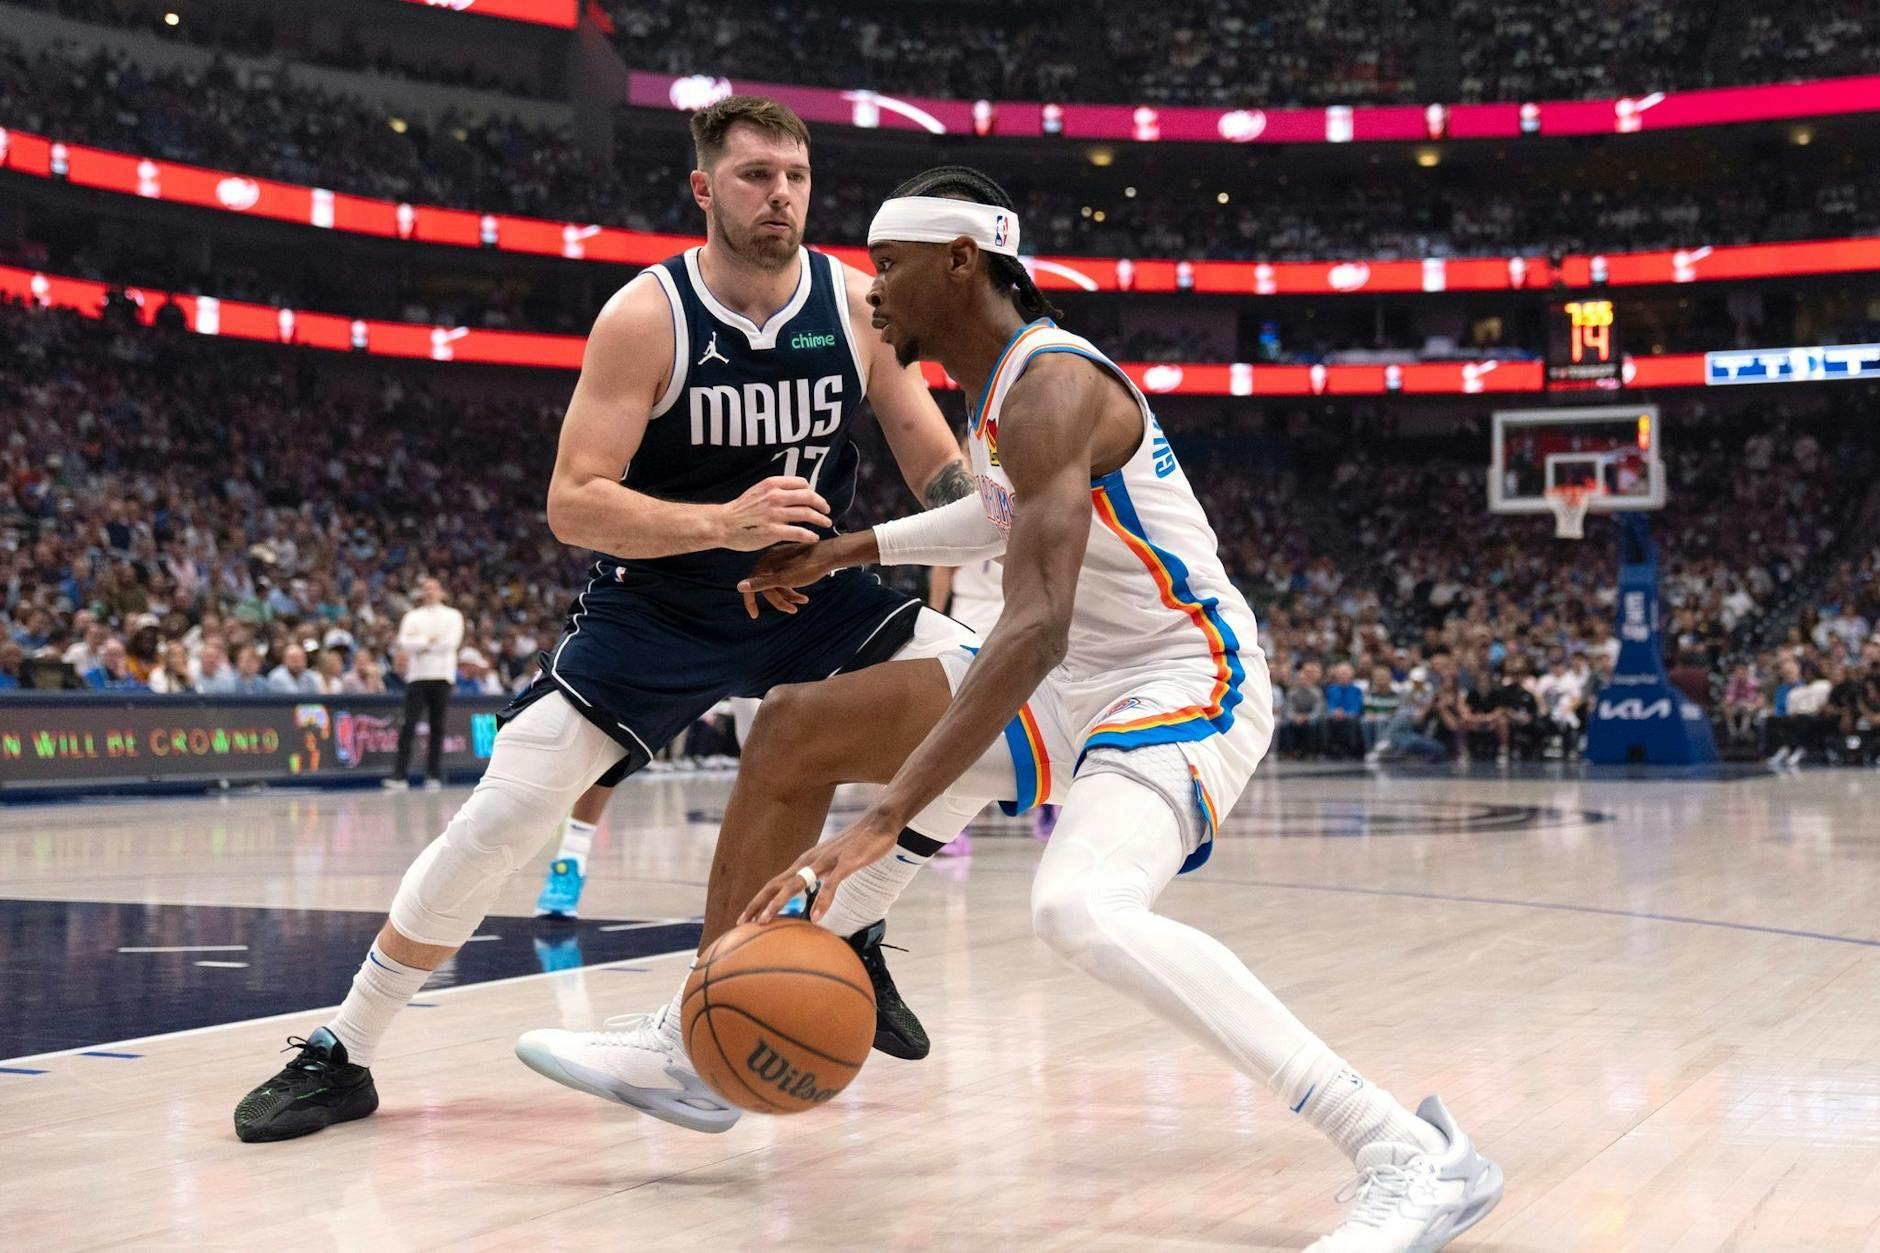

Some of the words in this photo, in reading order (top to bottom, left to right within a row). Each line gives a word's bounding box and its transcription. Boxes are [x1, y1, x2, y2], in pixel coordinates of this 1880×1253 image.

[791, 332, 836, 349] chime
[689, 374, 843, 447] MAVS
[31, 728, 99, 759] WILL
[105, 728, 139, 758] BE
[149, 727, 280, 757] CROWNED
[747, 1037, 843, 1102] Wilso
